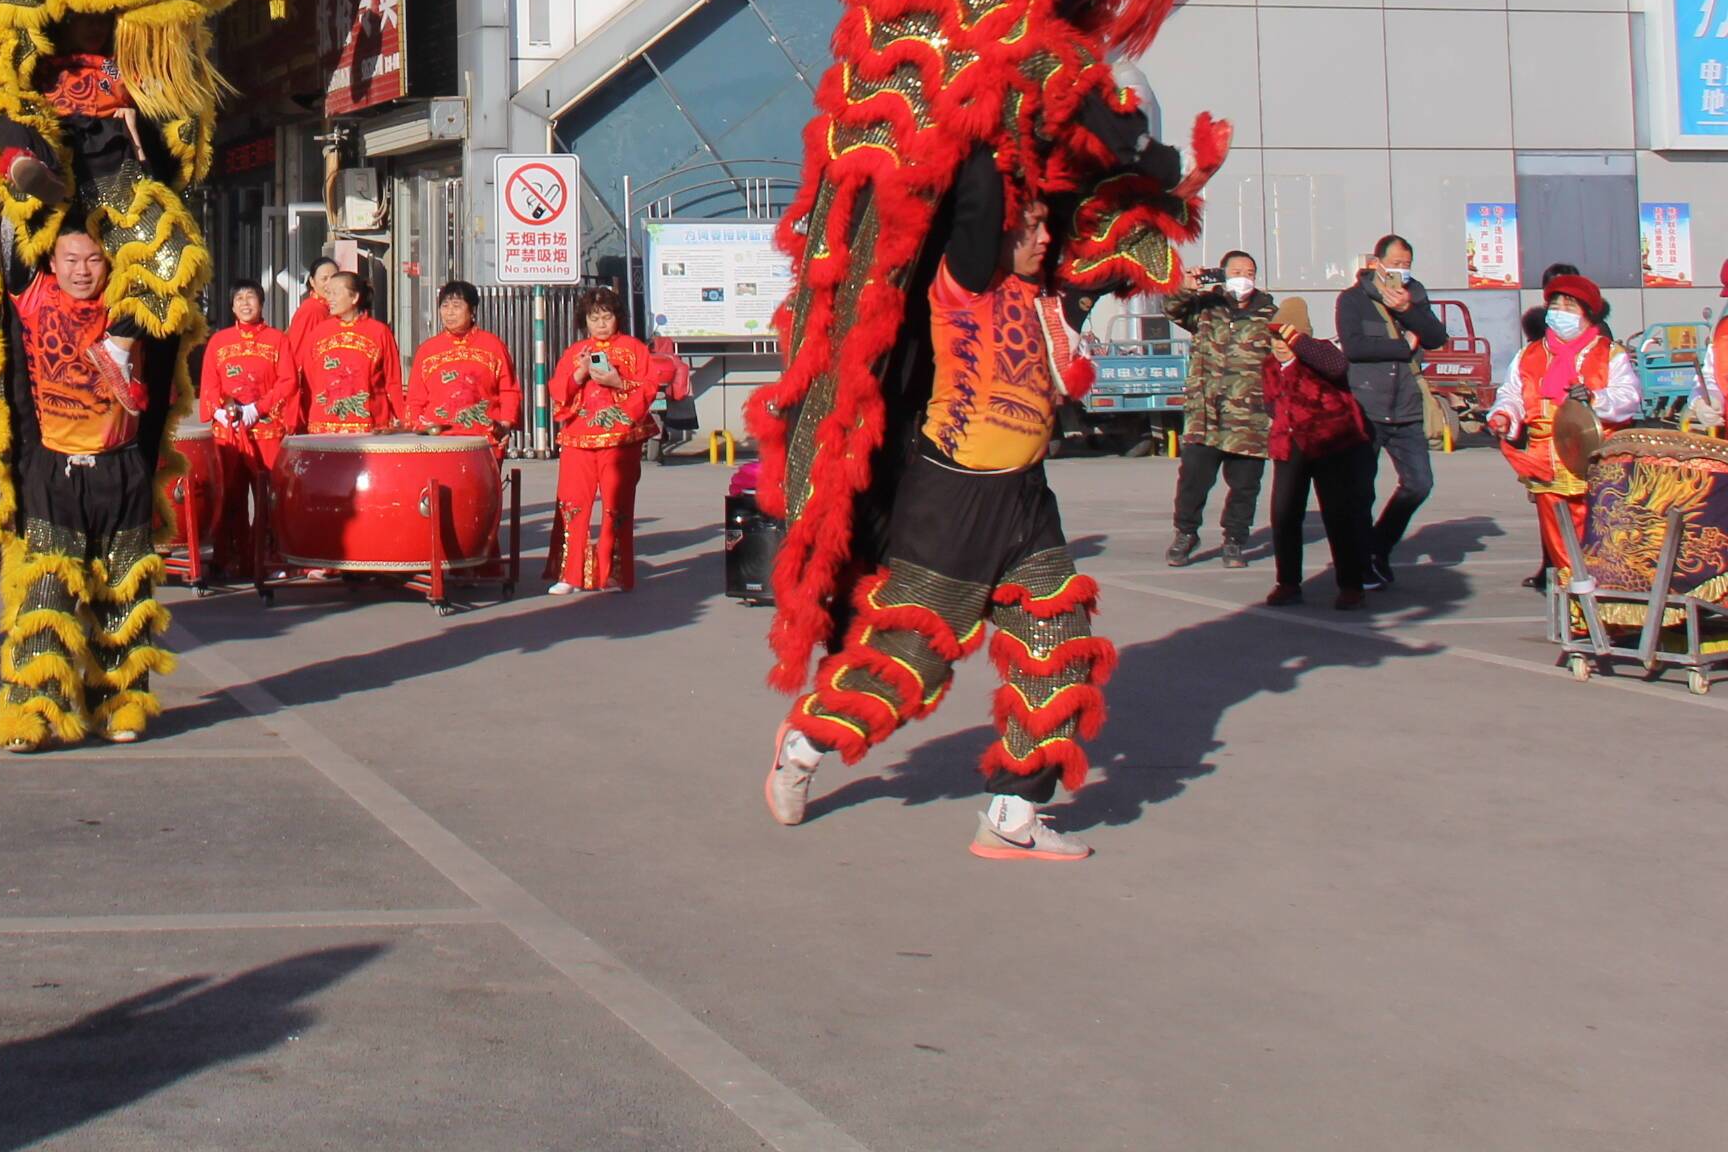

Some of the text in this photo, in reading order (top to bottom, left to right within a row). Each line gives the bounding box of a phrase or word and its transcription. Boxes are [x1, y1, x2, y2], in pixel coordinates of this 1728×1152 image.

[1700, 59, 1728, 86] 电
[1701, 88, 1728, 115] 地
[505, 232, 568, 246] 无烟市场
[505, 249, 568, 263] 严禁吸烟
[505, 265, 570, 275] No smoking
